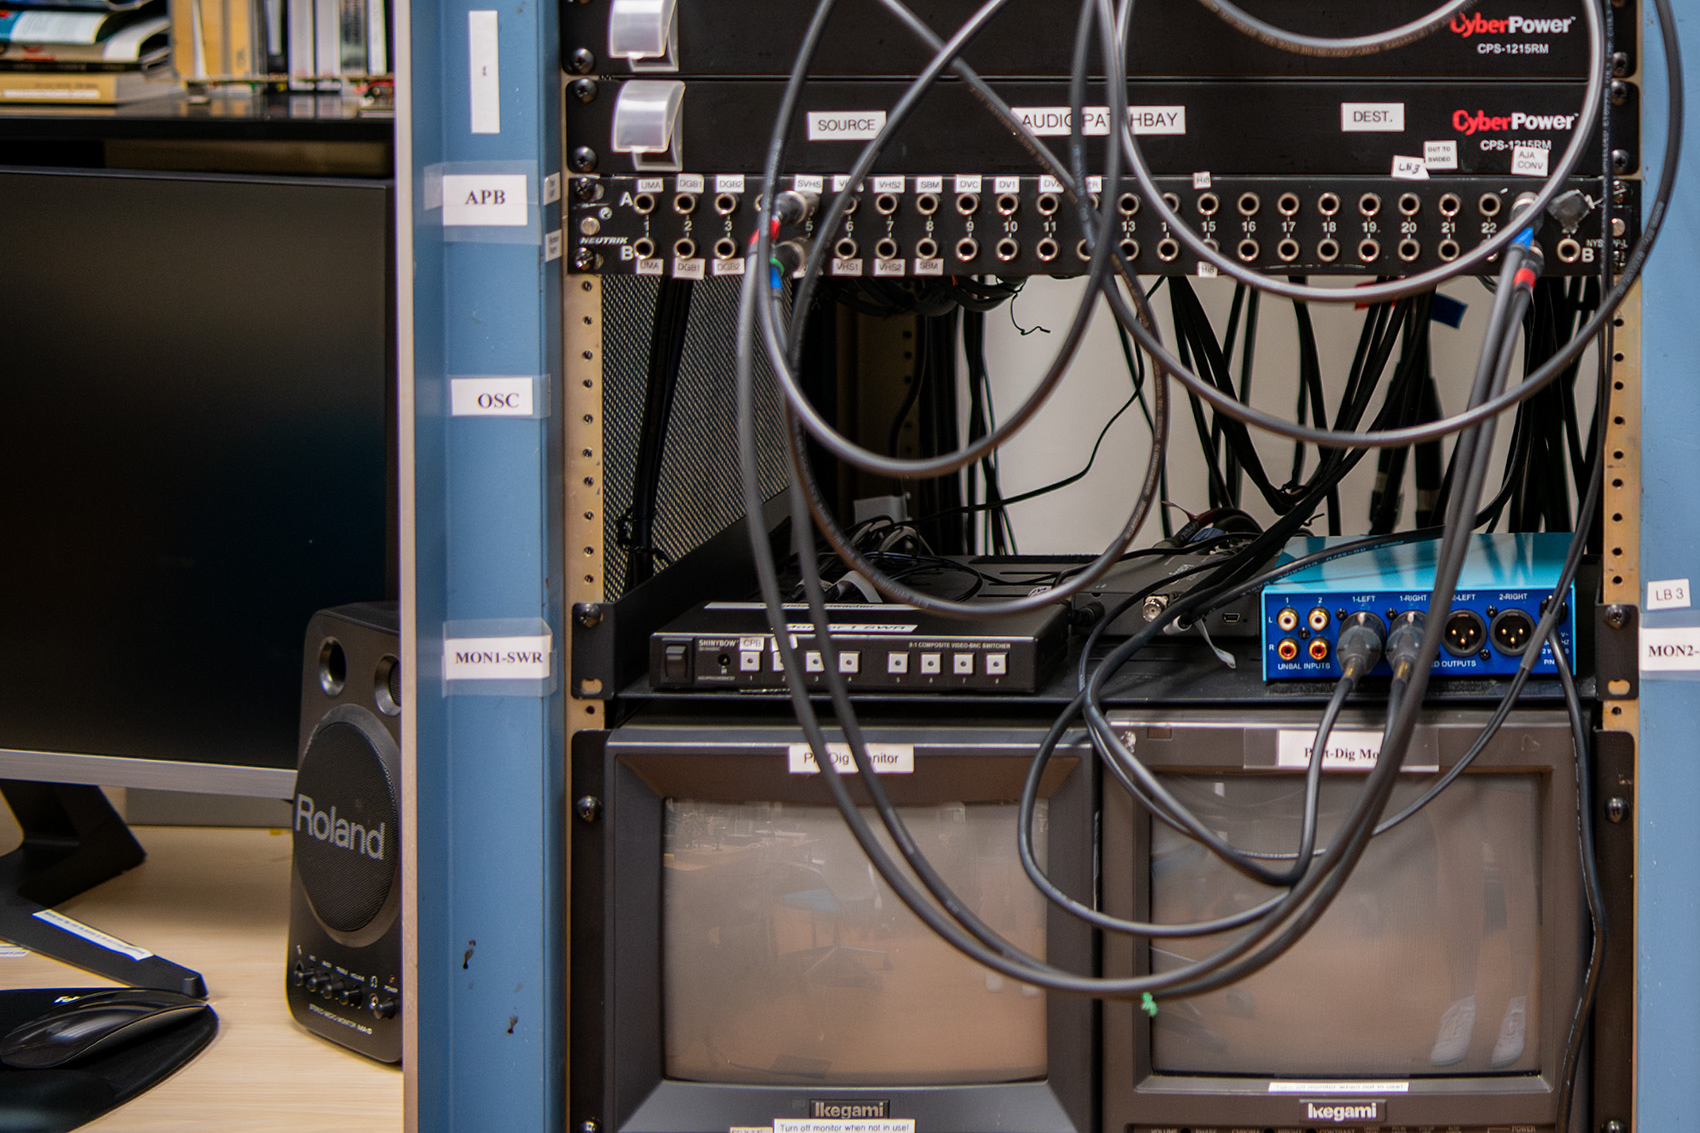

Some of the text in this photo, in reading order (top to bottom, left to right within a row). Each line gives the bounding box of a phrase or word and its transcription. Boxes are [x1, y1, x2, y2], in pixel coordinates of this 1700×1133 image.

[1451, 13, 1572, 34] CyberPower
[1477, 44, 1548, 54] CPS-1215RM
[1354, 111, 1393, 122] DEST.
[1453, 111, 1574, 133] CyberPower
[818, 118, 875, 131] SOURCE
[641, 181, 661, 189] UMA
[465, 190, 506, 205] APB
[620, 192, 633, 206] A
[1004, 221, 1017, 231] 10
[1282, 222, 1295, 232] 17
[1401, 223, 1416, 232] 20
[477, 393, 520, 409] OSC
[1499, 593, 1527, 601] 2-RIGHT
[1656, 588, 1683, 601] LB 3
[455, 650, 543, 666] MON1-SWR
[296, 795, 385, 861] Roland
[815, 1102, 884, 1119] Ikegami
[1308, 1103, 1376, 1120] Ikegami
